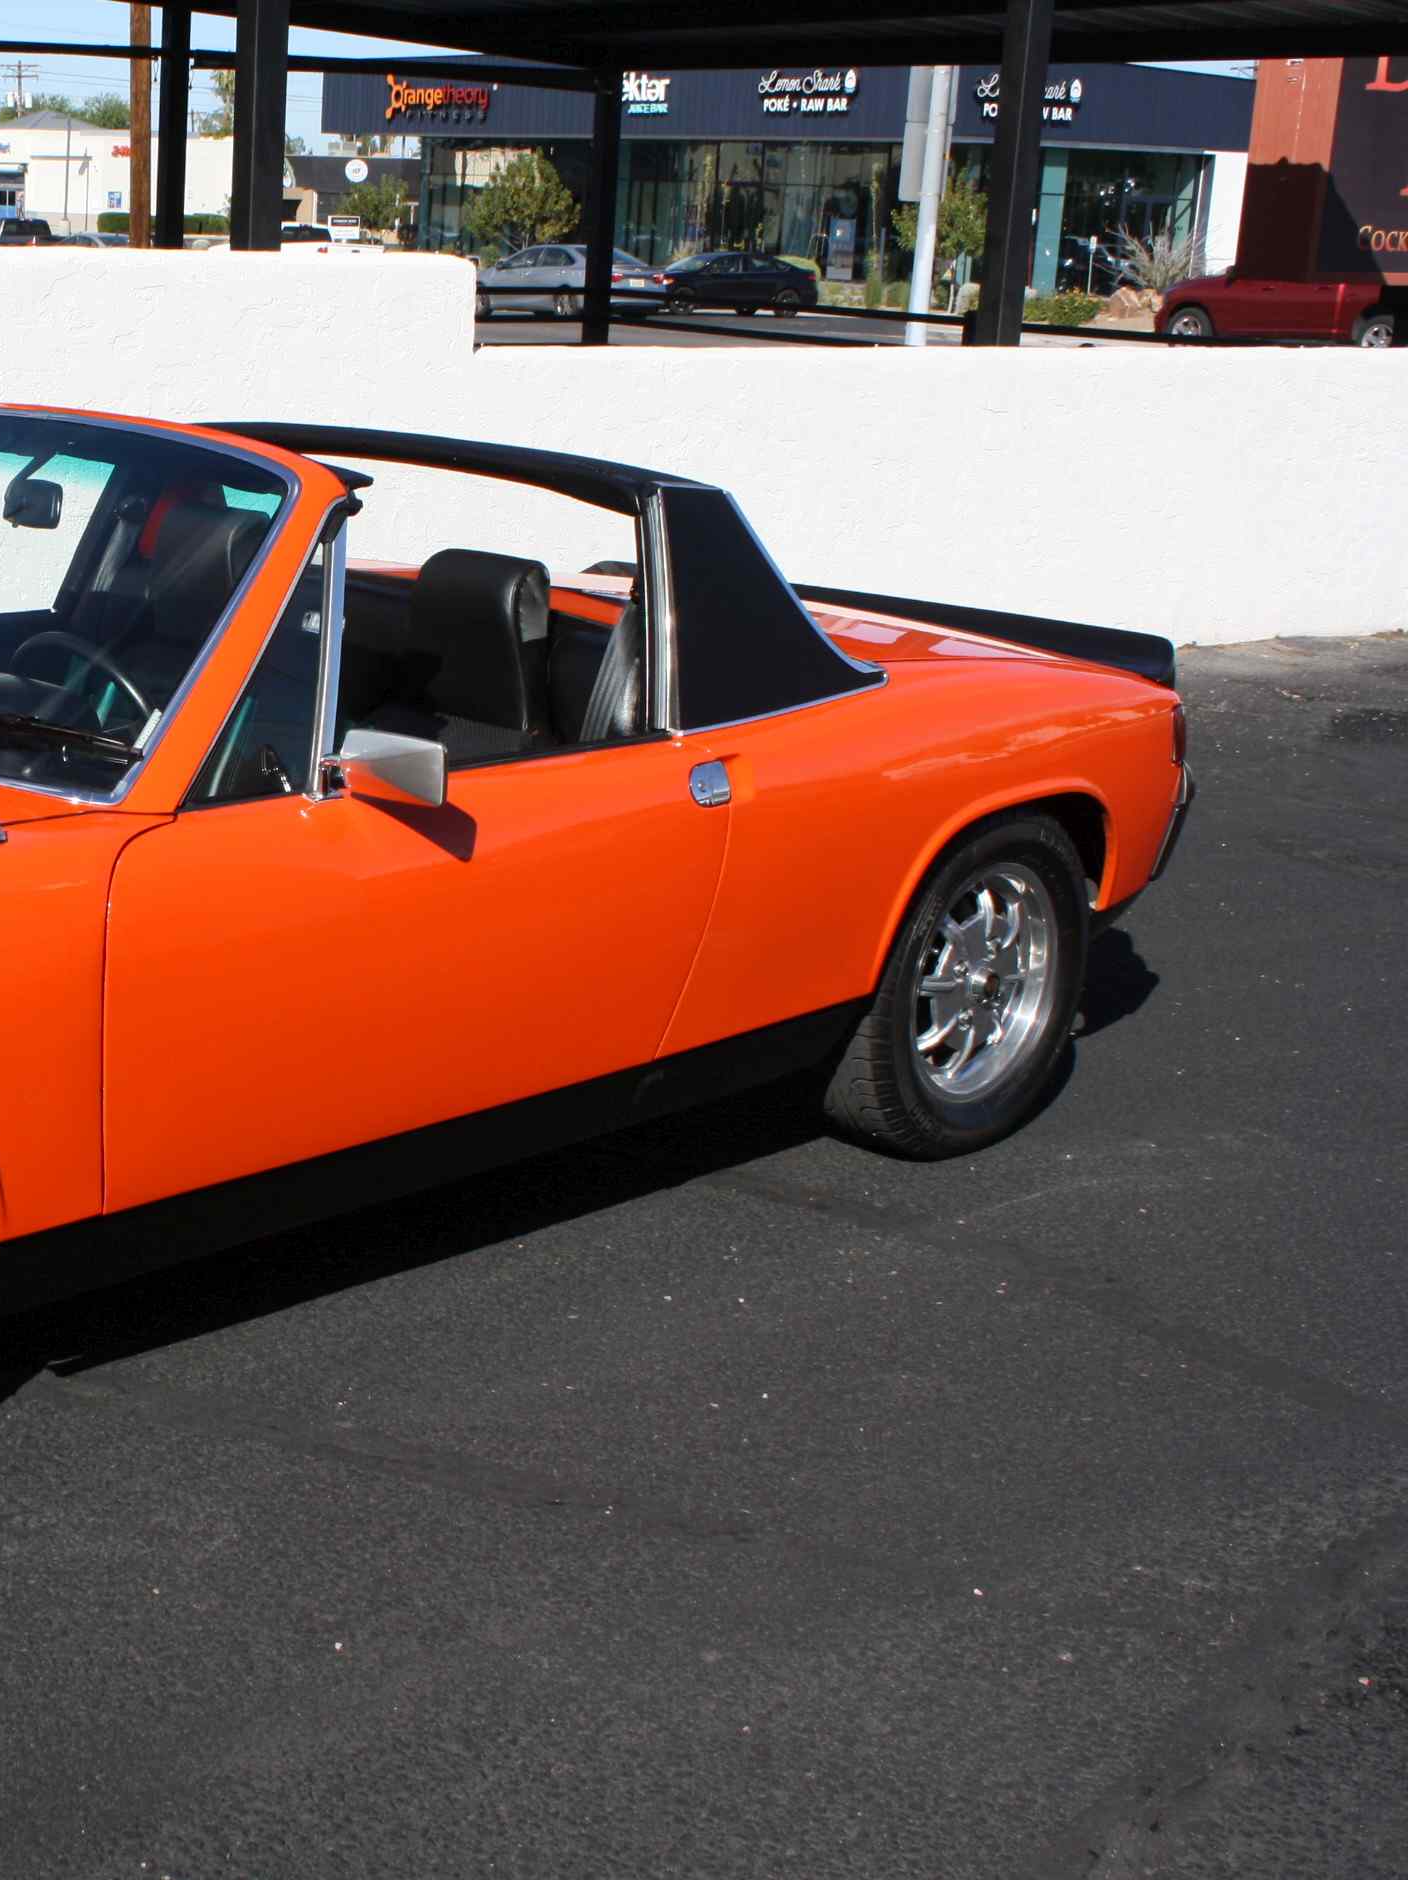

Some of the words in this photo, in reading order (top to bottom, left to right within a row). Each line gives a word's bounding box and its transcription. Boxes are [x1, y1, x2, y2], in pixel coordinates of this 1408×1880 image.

[758, 70, 801, 94] Lemon
[802, 70, 841, 94] Shark
[800, 98, 824, 112] RAW
[826, 98, 848, 112] BAR
[983, 102, 999, 118] PO
[1052, 107, 1072, 121] BAR
